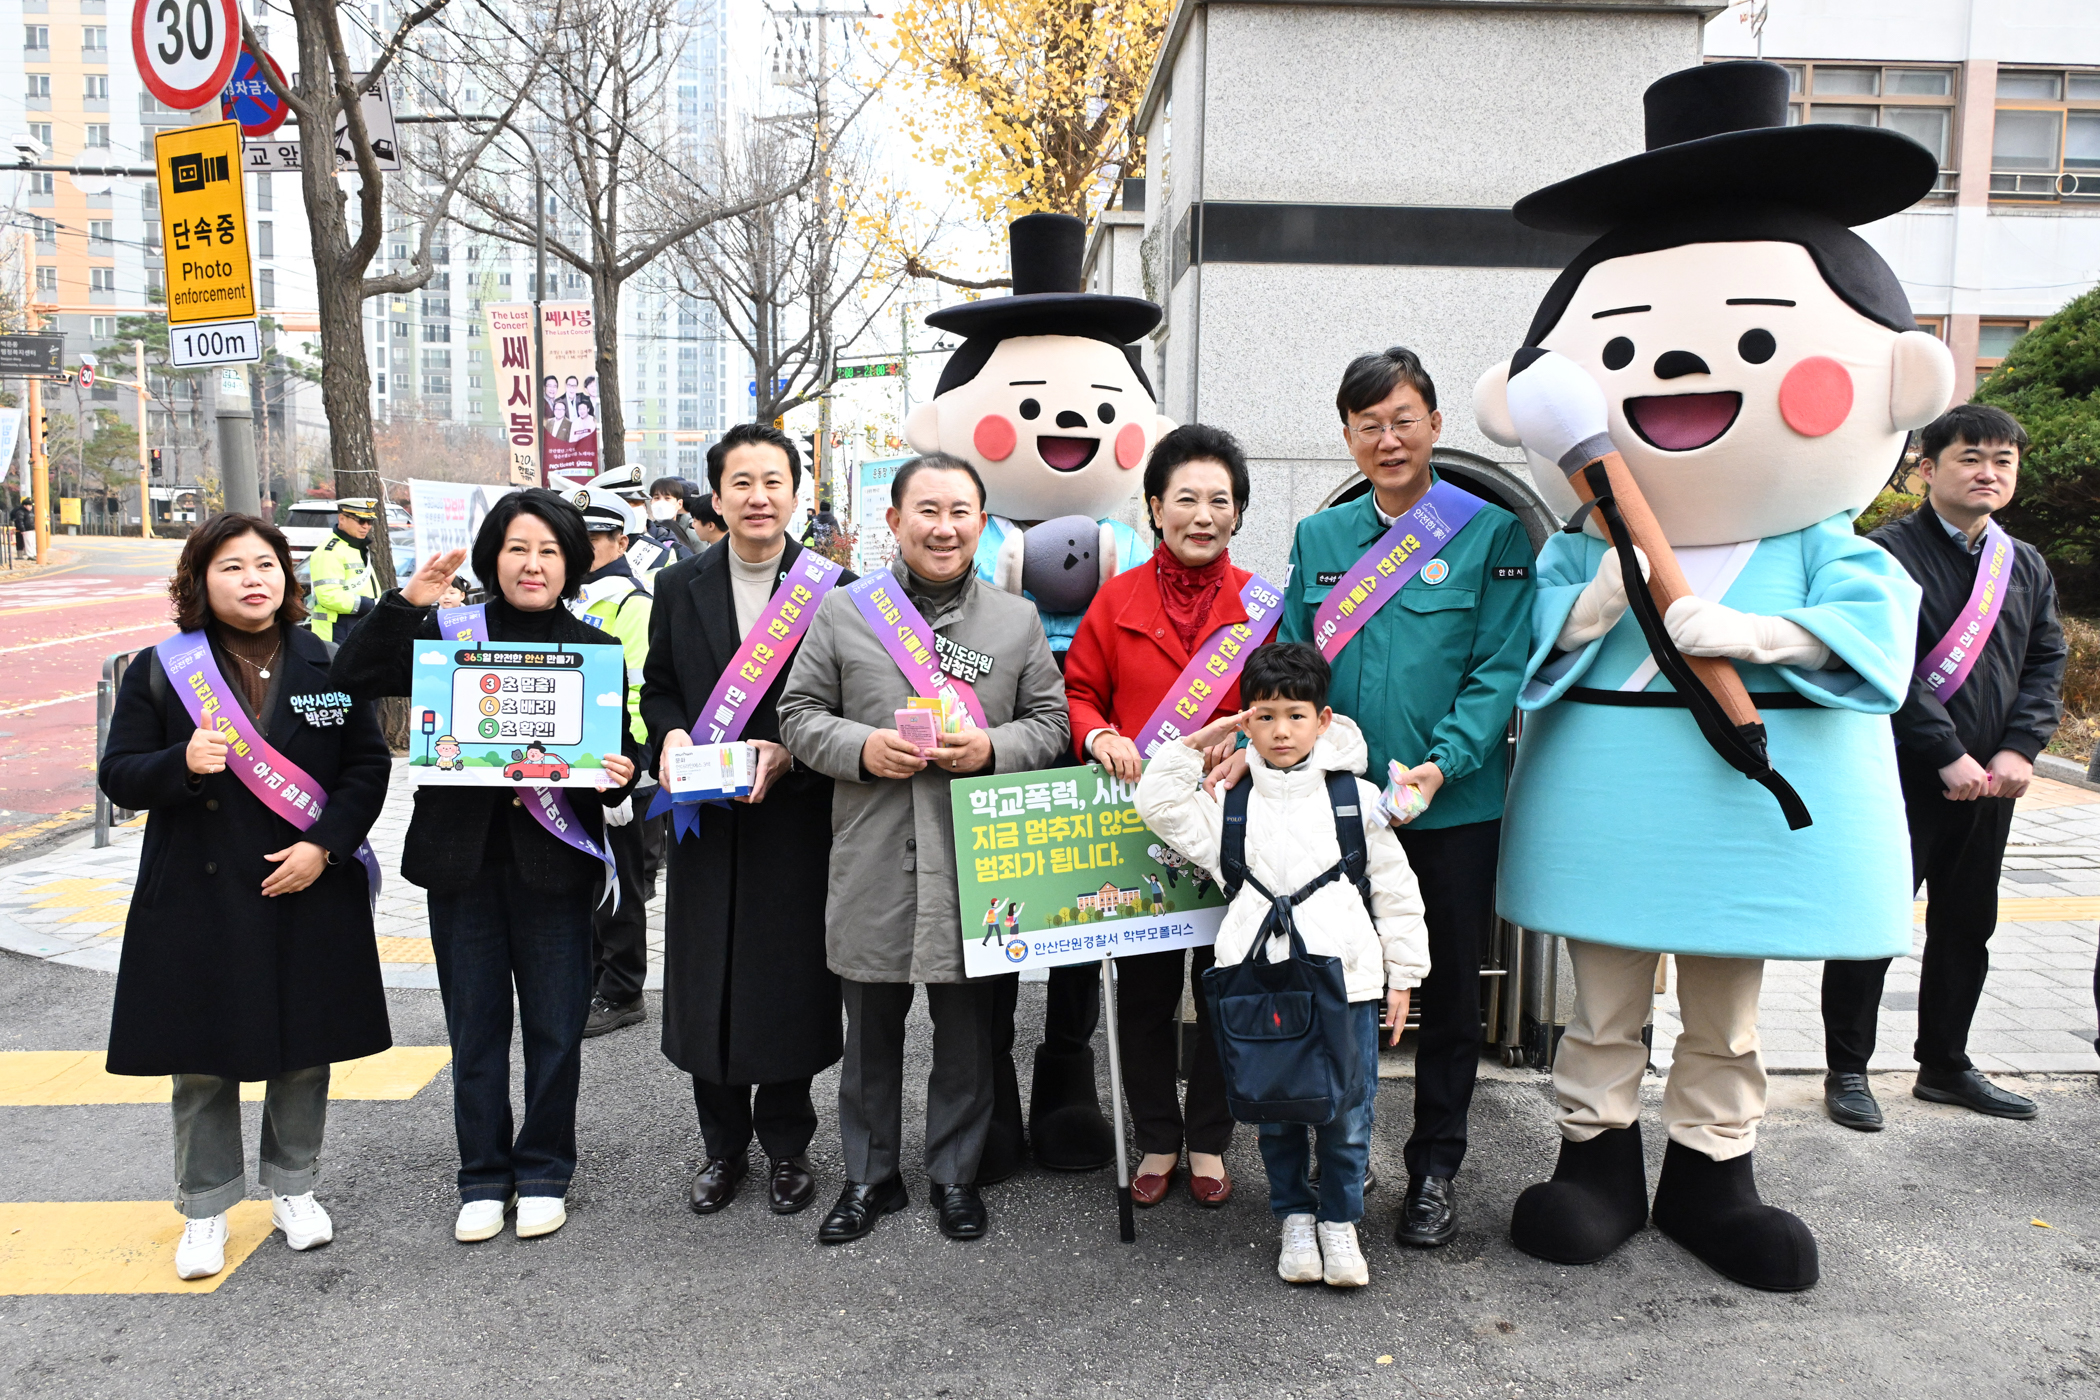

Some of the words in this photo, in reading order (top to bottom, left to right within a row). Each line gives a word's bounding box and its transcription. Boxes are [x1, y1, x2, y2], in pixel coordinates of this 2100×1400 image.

[157, 0, 213, 65] 30
[173, 213, 235, 250] 단속중
[182, 260, 232, 281] Photo
[174, 283, 246, 305] enforcement
[491, 311, 508, 319] The
[510, 311, 528, 319] Last
[493, 321, 528, 330] Concert
[545, 310, 592, 327] 쎄시봉
[184, 331, 246, 358] 100m
[82, 370, 92, 382] 30
[502, 336, 534, 446] 쎄시봉
[1413, 508, 1437, 532] 안전한
[1376, 533, 1421, 578] 안전한
[1989, 542, 2007, 579] 안전한
[1498, 568, 1523, 577] 안산시
[1338, 576, 1377, 617] 스쿨존
[443, 615, 468, 628] 안전한
[767, 584, 813, 641] 안전한
[870, 587, 902, 626] 안전한
[897, 626, 932, 666] 스쿨존
[456, 628, 474, 642] 안
[1959, 620, 1980, 648] 우리
[464, 653, 492, 663] 365일
[494, 654, 522, 664] 안전한
[524, 654, 545, 664] 안산
[546, 655, 575, 664] 만들기
[739, 642, 775, 683] 안산
[934, 633, 994, 674] 경기도의원
[1206, 623, 1252, 678] 안전한
[1939, 646, 1966, 676] 함께
[170, 658, 194, 674] 안전한
[939, 653, 978, 683] 김철진
[521, 677, 556, 693] 멈춤!
[1175, 678, 1212, 720] 안산
[290, 691, 352, 713] 안산시의원
[520, 699, 556, 716] 배려!
[709, 685, 747, 744] 만들기
[305, 708, 345, 727] 박은정
[519, 721, 555, 738] 확인!
[188, 671, 221, 715] 안전한
[253, 761, 287, 790] 우리
[281, 783, 311, 810] 함께
[968, 779, 1086, 818] 학교폭력,
[971, 821, 1019, 851] 지금
[1025, 812, 1093, 846] 멈추지
[1099, 809, 1151, 837] 않으
[975, 849, 1046, 883] 범죄가
[1050, 841, 1124, 874] 됩니다.
[1034, 932, 1119, 956] 안산단원경찰서
[1123, 923, 1194, 943] 학부모폴리스
